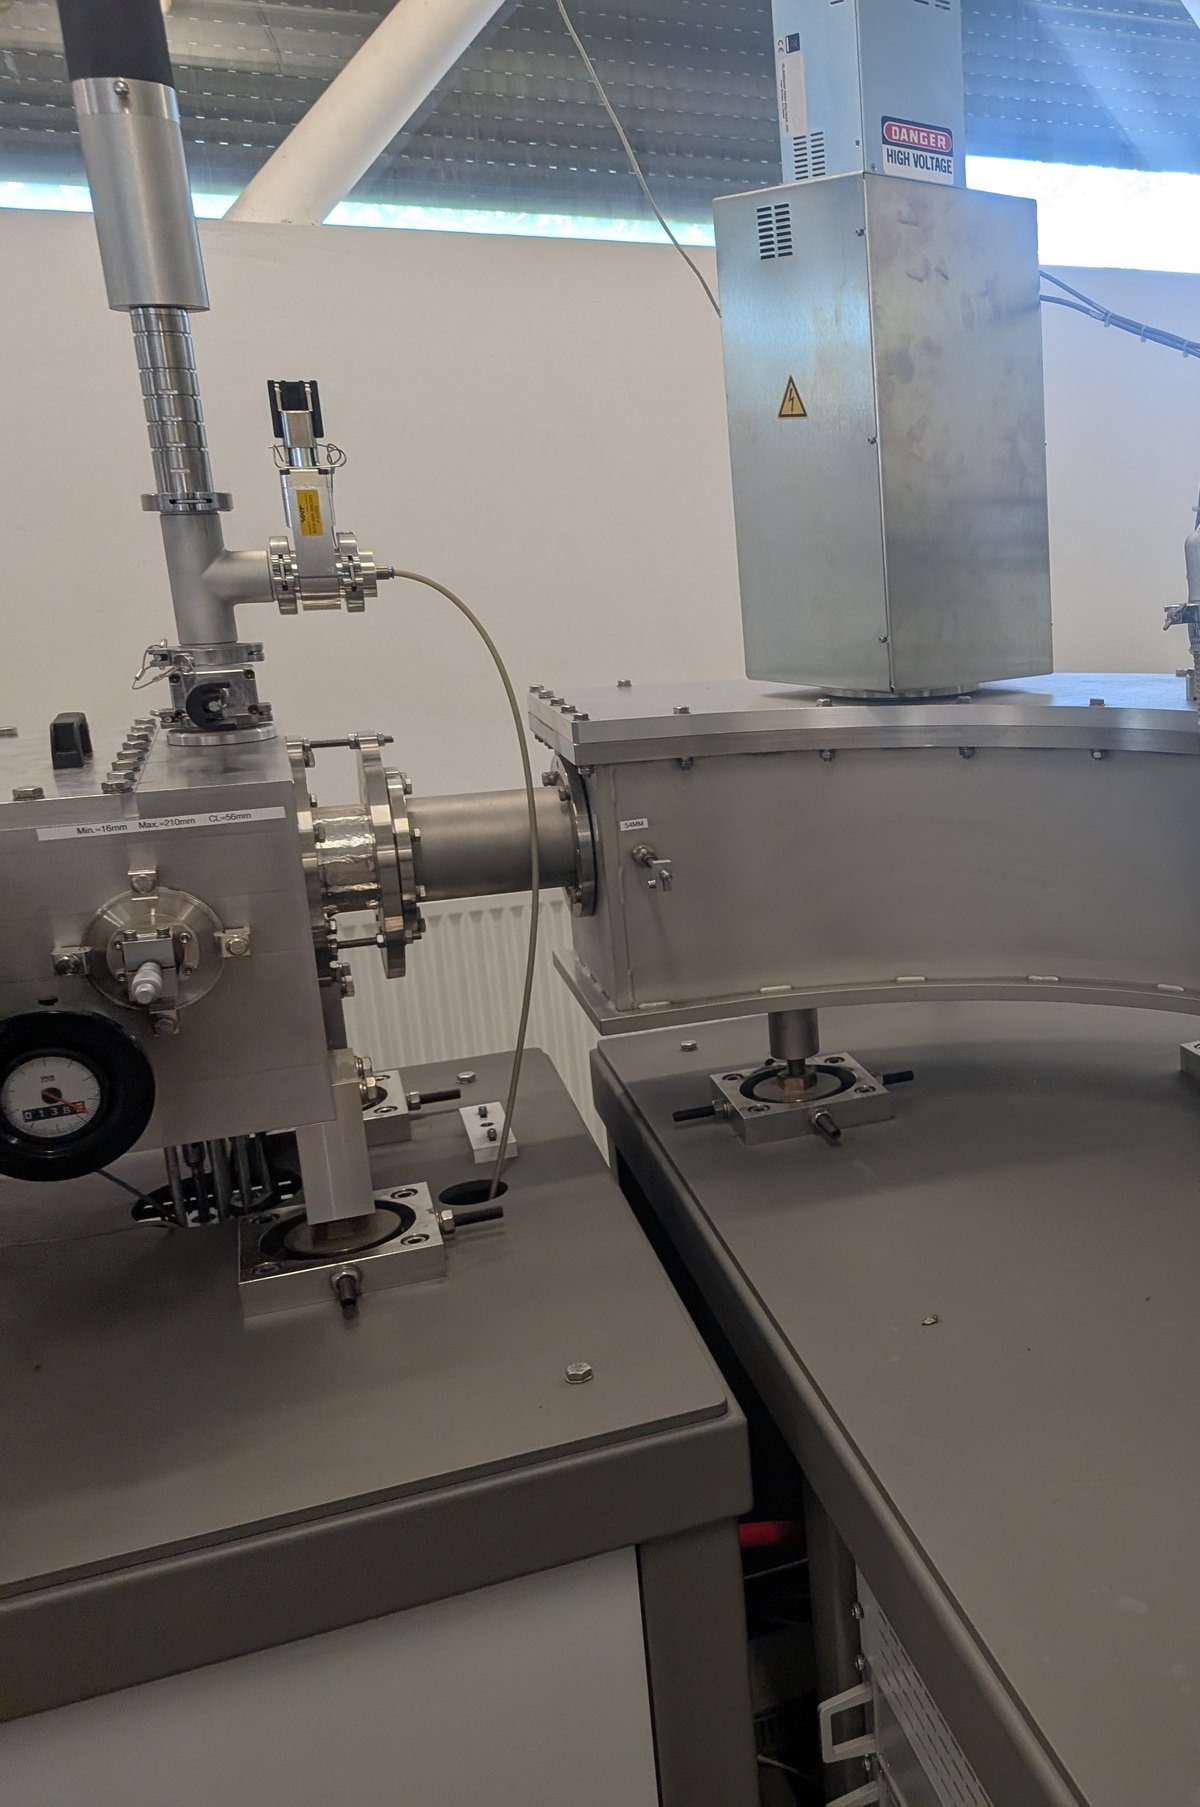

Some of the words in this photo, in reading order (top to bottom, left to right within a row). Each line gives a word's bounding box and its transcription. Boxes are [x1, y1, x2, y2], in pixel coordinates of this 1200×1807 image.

[892, 126, 946, 149] DANGER
[886, 148, 911, 167] HIGH
[912, 152, 953, 175] VOLTAGE
[208, 812, 252, 823] CL=56mm
